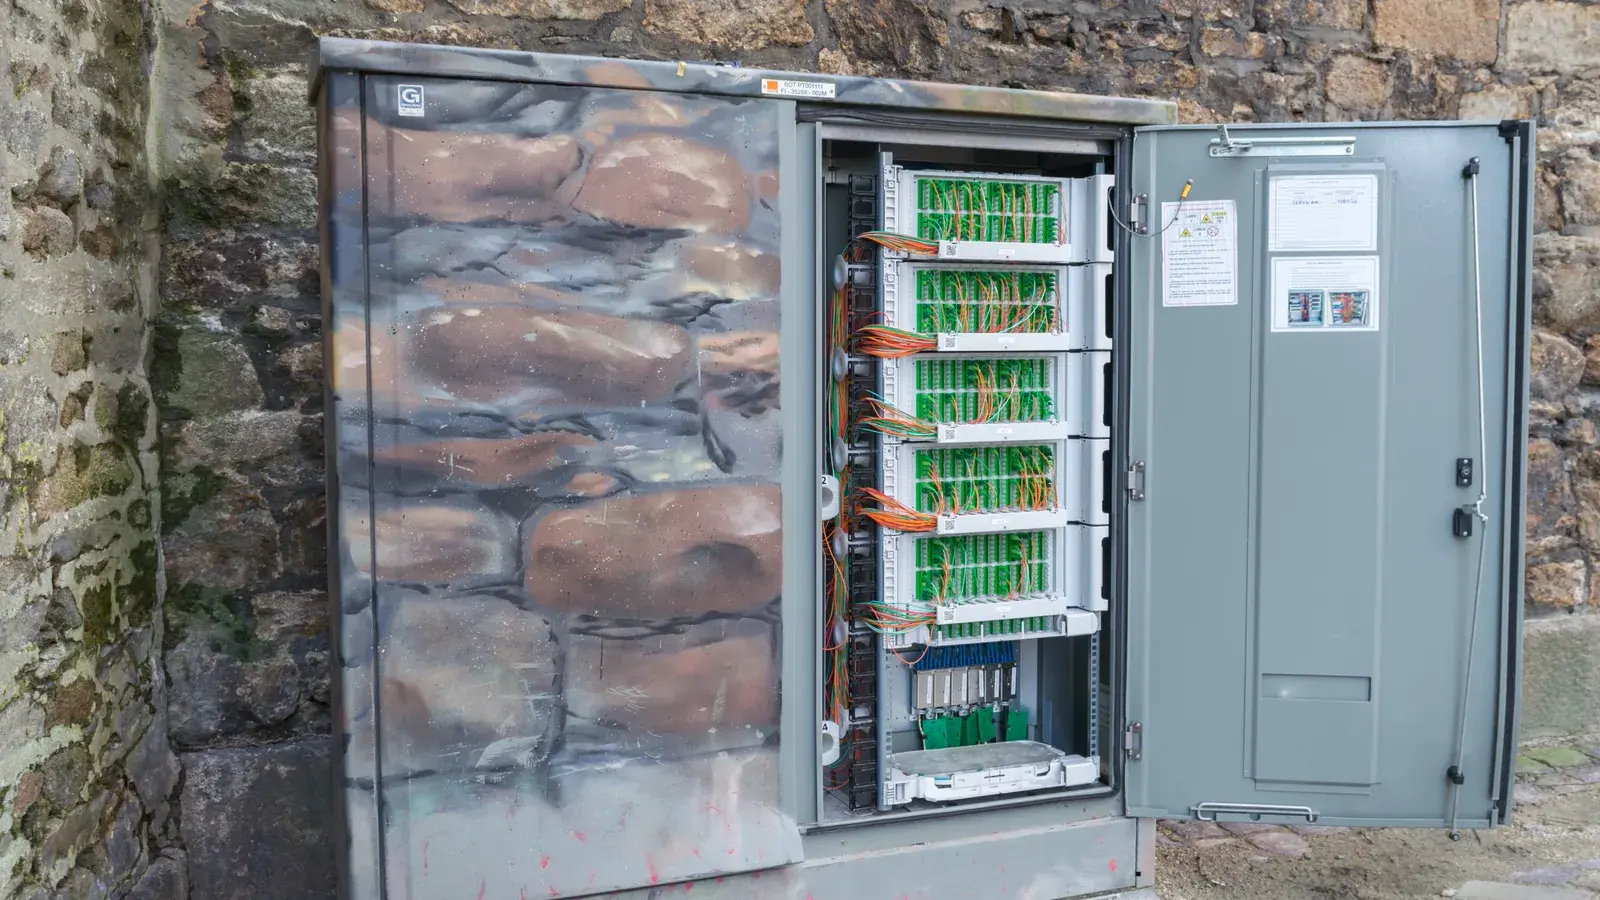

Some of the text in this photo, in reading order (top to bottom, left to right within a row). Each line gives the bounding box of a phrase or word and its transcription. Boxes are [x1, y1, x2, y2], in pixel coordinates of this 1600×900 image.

[402, 88, 420, 103] G
[821, 476, 826, 485] 2
[822, 723, 828, 731] 4
